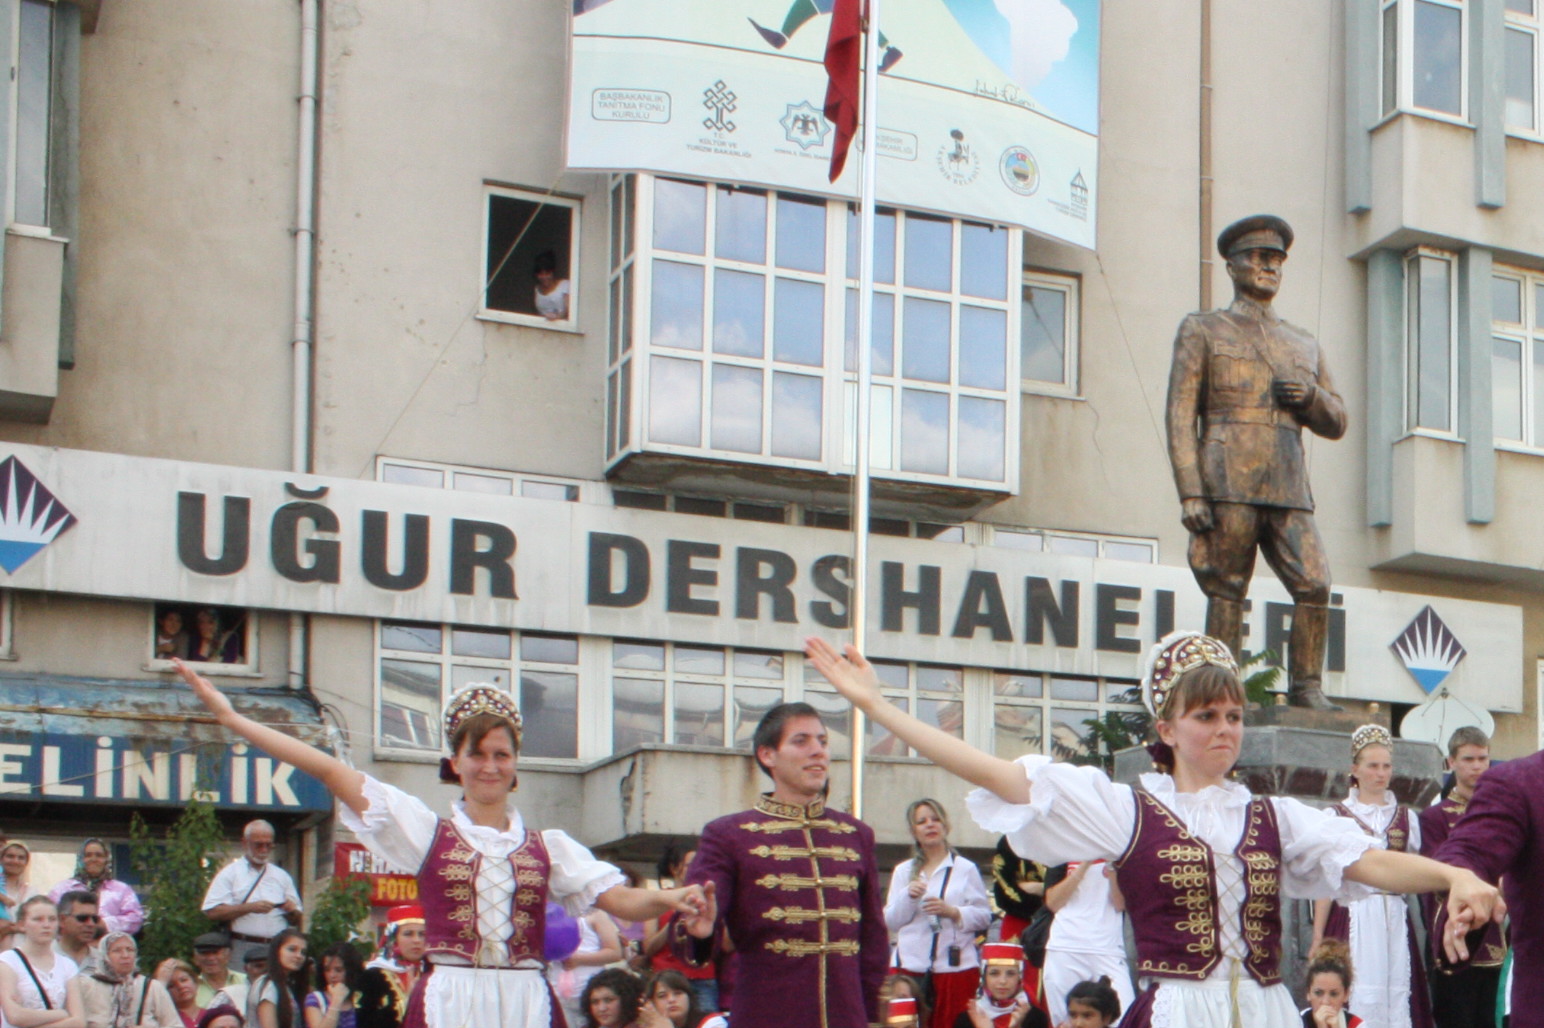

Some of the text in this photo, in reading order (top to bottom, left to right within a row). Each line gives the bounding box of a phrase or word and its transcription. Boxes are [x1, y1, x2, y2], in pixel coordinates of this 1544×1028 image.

[600, 92, 664, 103] BAŞBAKANLIK
[639, 104, 665, 112] FONU
[612, 110, 650, 119] KURULU
[177, 482, 520, 600] UĞUR
[377, 877, 419, 901] FOTO
